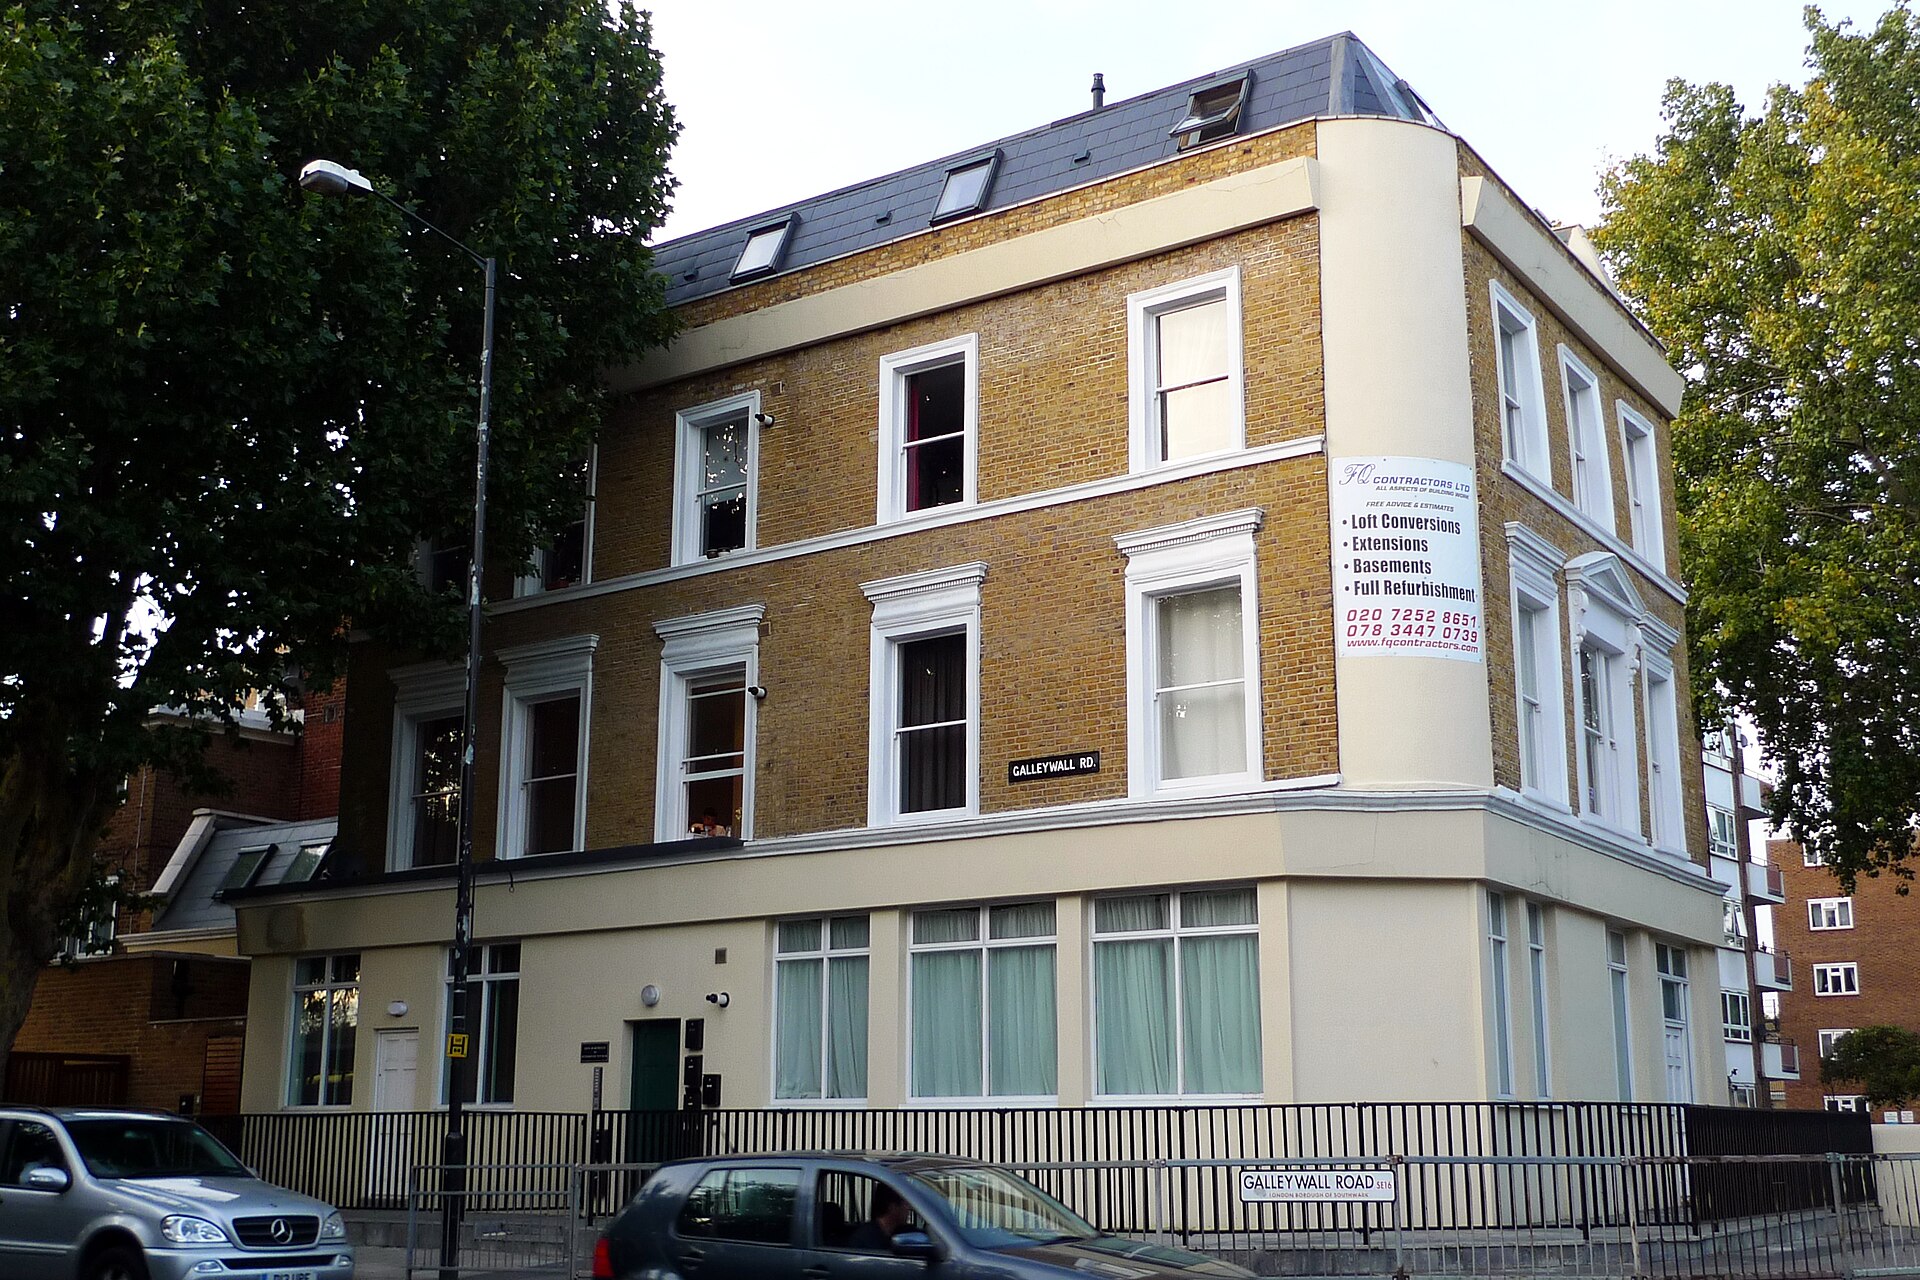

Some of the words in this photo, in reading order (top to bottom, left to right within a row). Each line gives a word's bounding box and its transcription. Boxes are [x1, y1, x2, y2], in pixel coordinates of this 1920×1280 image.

[1373, 476, 1453, 488] CONTRACTORS
[1455, 483, 1470, 493] LTD
[1429, 488, 1454, 496] BUILDING
[1420, 502, 1454, 512] ESTIMATES
[1352, 514, 1378, 529] Loft
[1382, 514, 1461, 535] Conversions
[1353, 536, 1428, 552] Extensions
[1354, 559, 1432, 574] Basements
[1354, 580, 1379, 595] Full
[1384, 580, 1476, 603] Refurbishment
[1347, 609, 1382, 622] 020
[1391, 609, 1435, 622] 7252
[1442, 612, 1477, 628] 8651
[1347, 624, 1382, 637] 078
[1391, 624, 1435, 638] 3447
[1442, 627, 1477, 643] 0739
[1347, 637, 1478, 653] www.fqcontractors.com
[1013, 759, 1075, 776] GALLEYWALL
[1080, 757, 1096, 768] RD.
[1244, 1175, 1330, 1190] GALLEYWALL
[1336, 1175, 1374, 1189] ROAD
[1377, 1181, 1392, 1189] SE16
